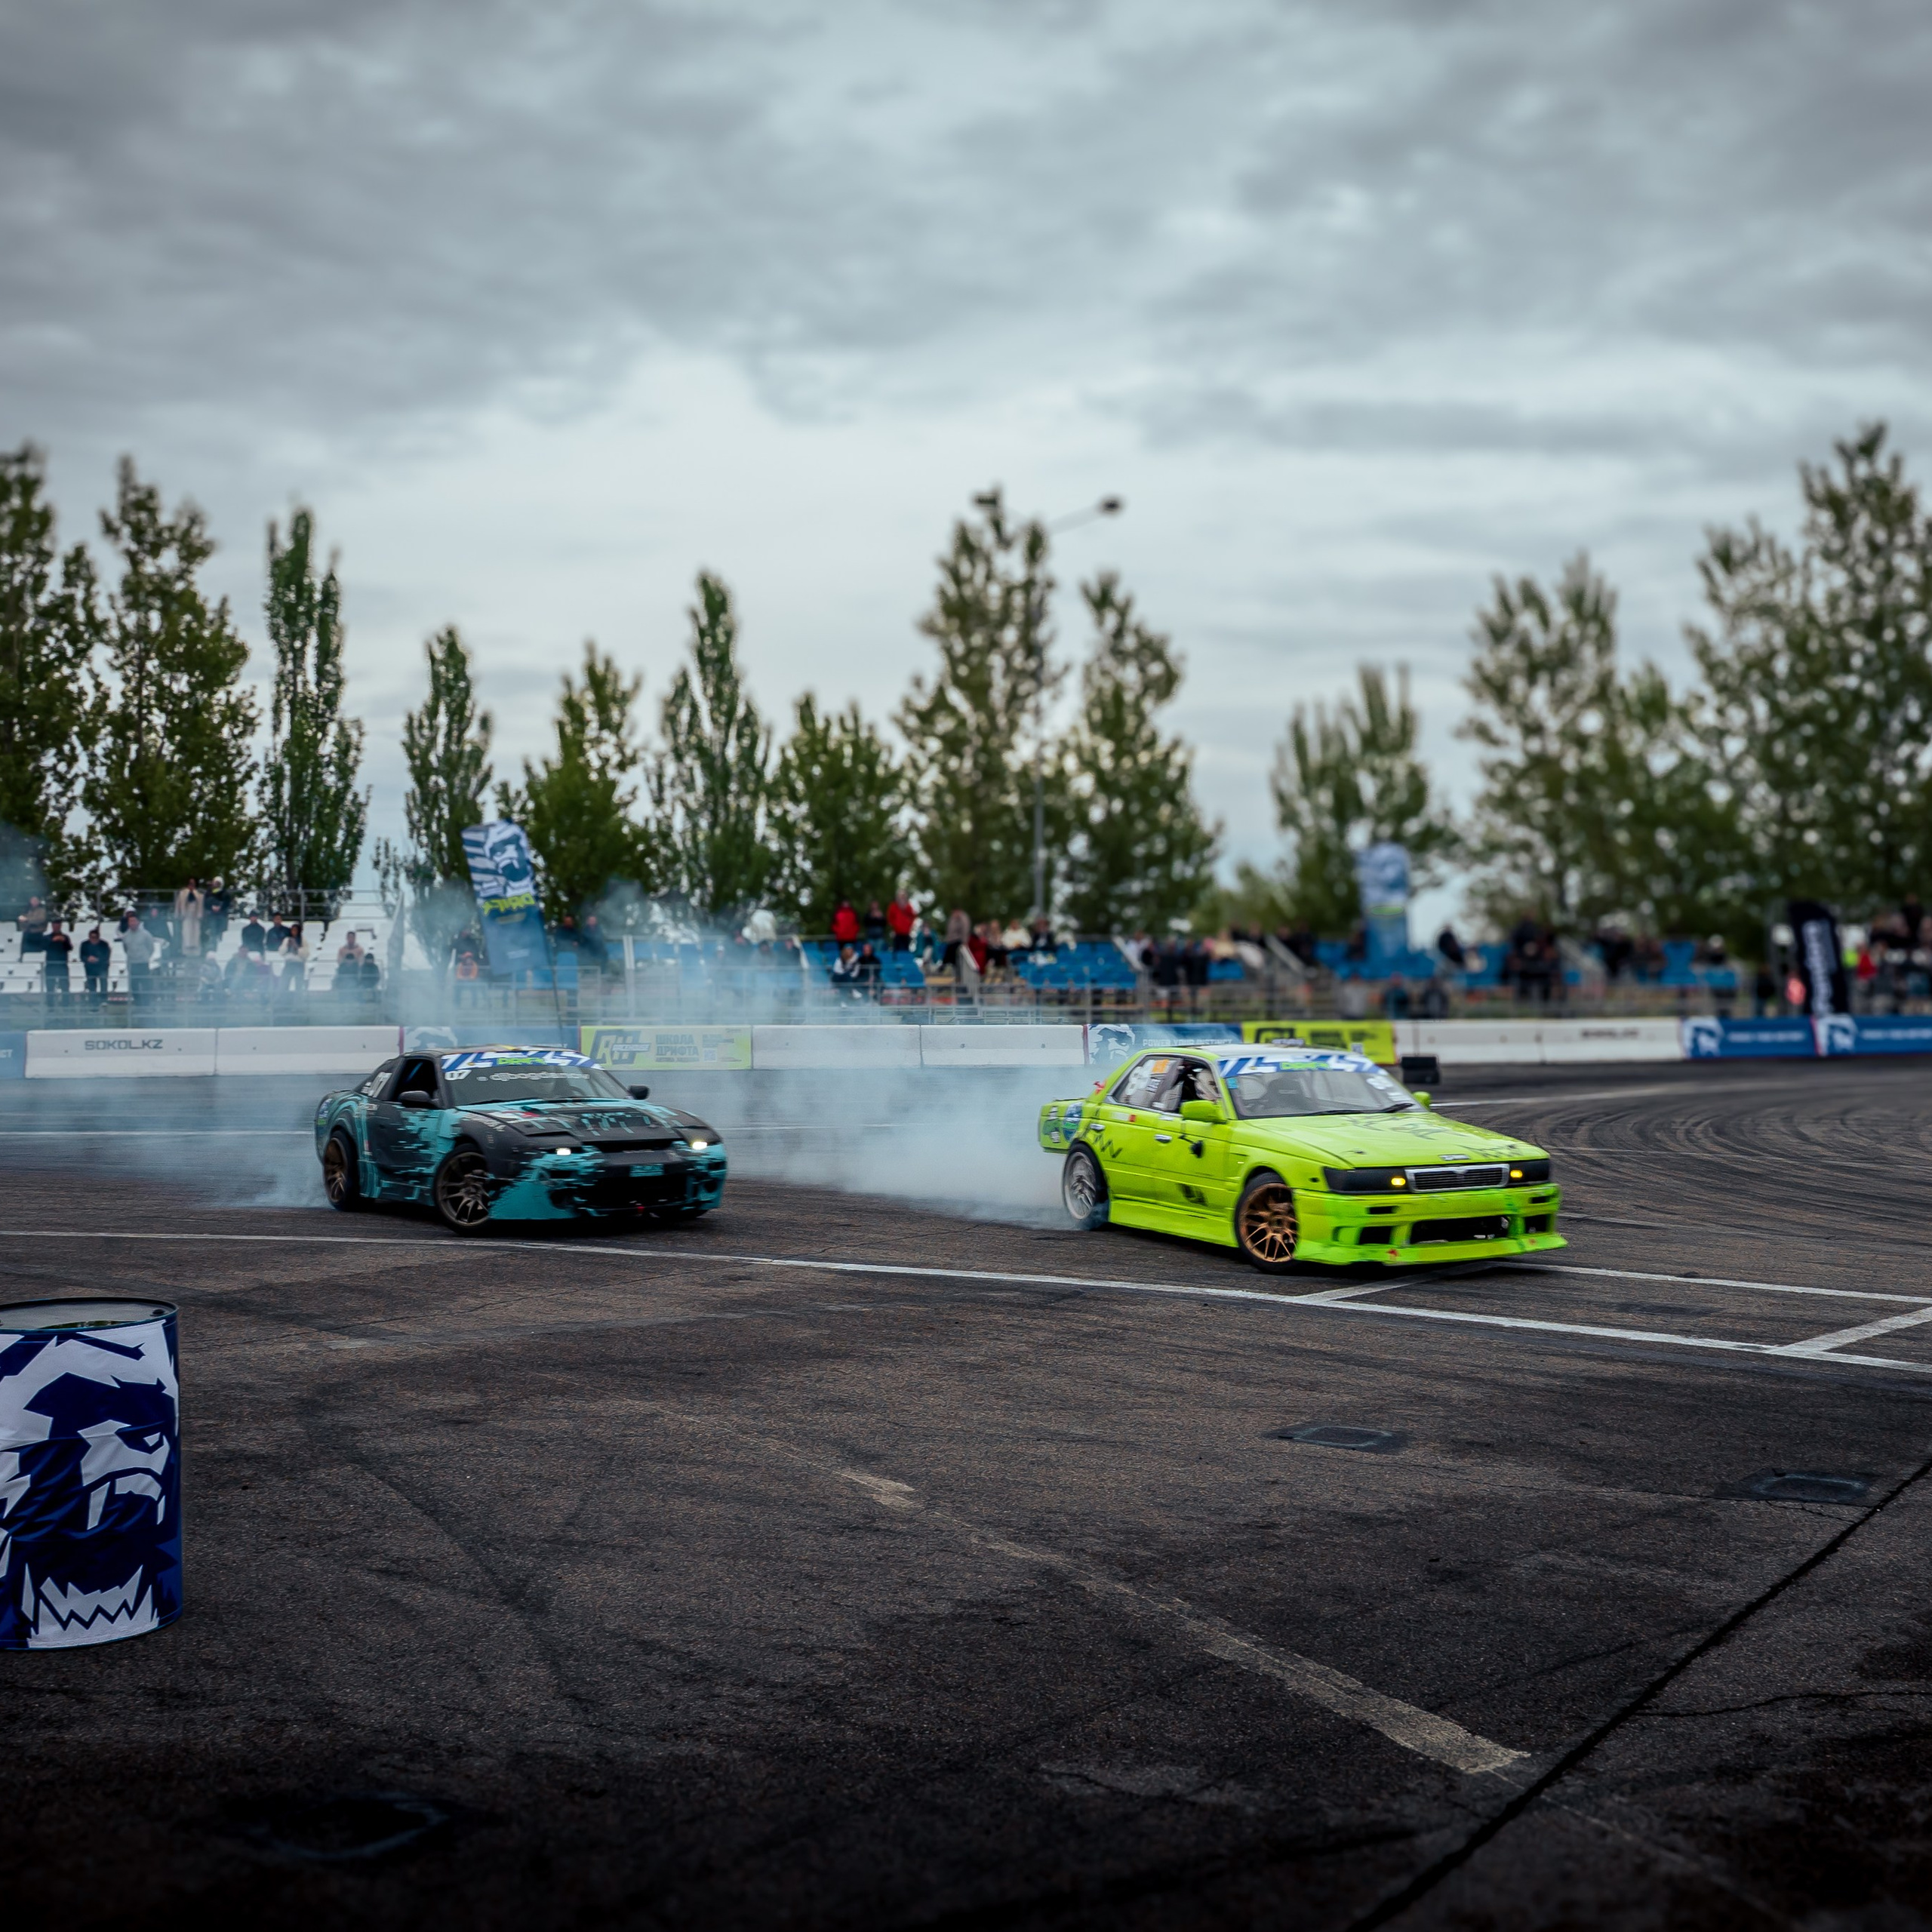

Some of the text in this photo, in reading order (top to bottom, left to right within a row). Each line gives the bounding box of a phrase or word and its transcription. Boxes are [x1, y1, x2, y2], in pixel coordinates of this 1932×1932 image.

[656, 1035, 694, 1044] ШКОЛА
[656, 1046, 700, 1056] ДРИФТА
[445, 1069, 472, 1081] 07
